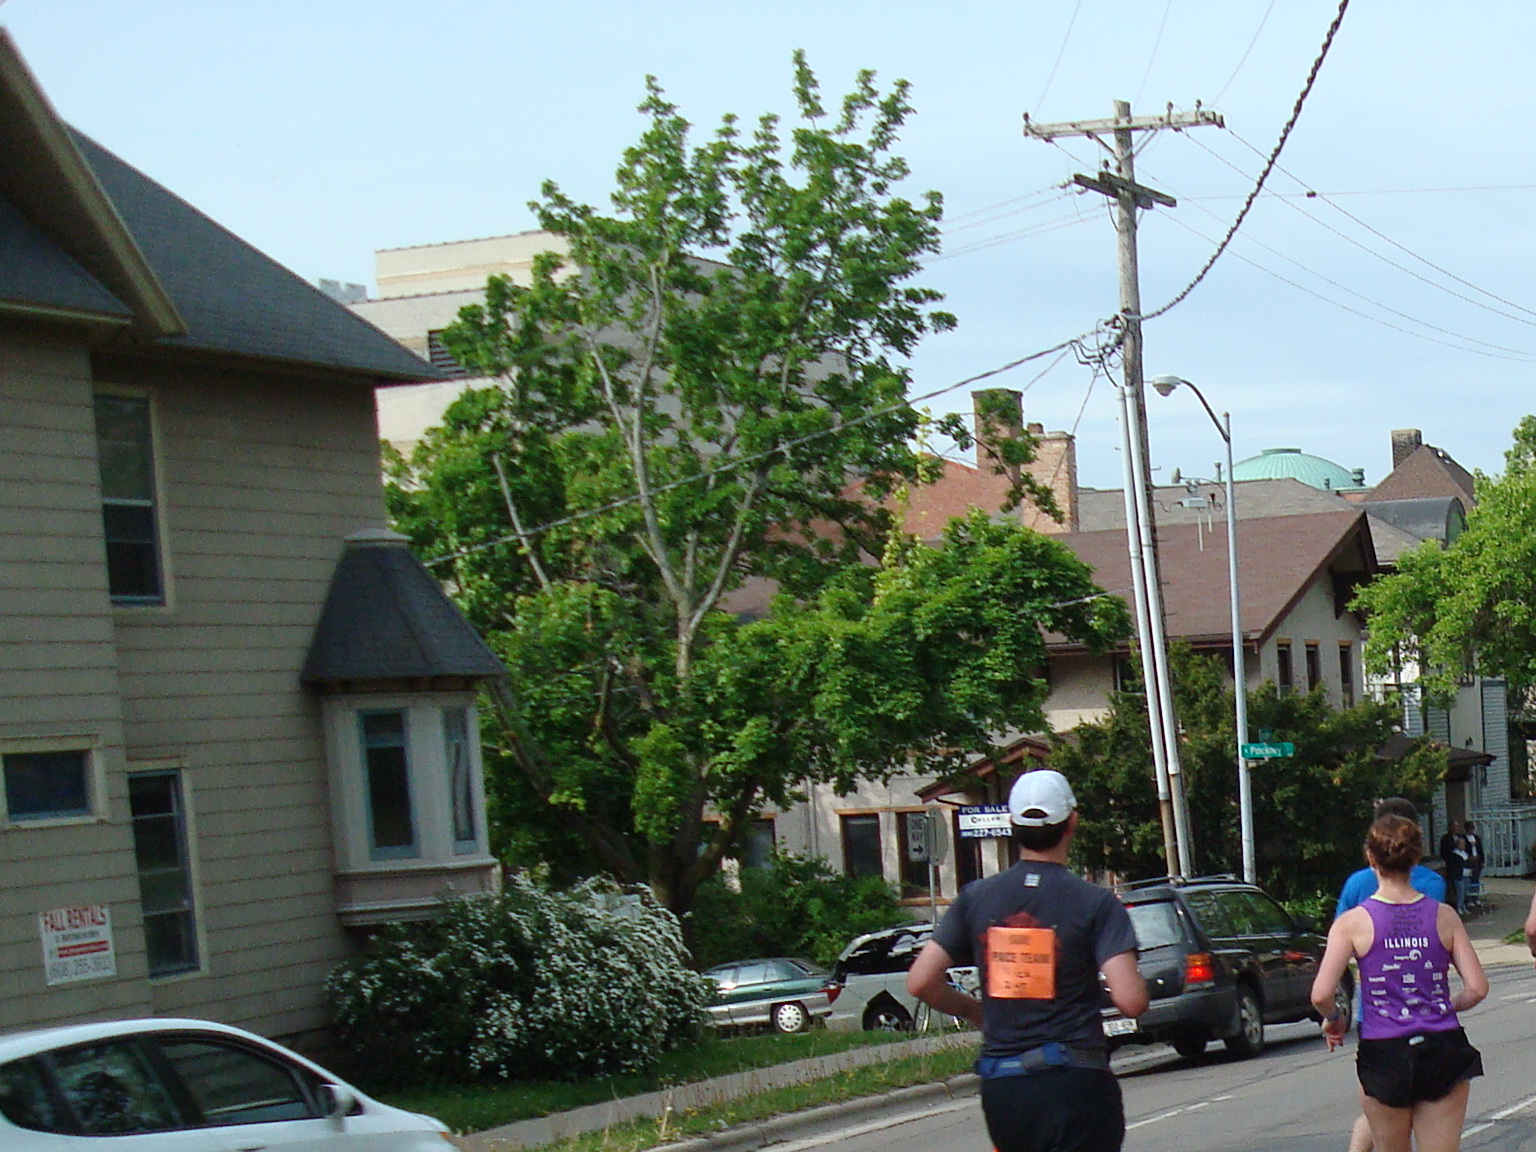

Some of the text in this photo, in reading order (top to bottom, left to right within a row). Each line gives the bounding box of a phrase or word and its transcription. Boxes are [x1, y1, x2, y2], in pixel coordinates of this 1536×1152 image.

[962, 804, 1009, 814] FOR SALE
[1384, 936, 1429, 949] ILLINOIS
